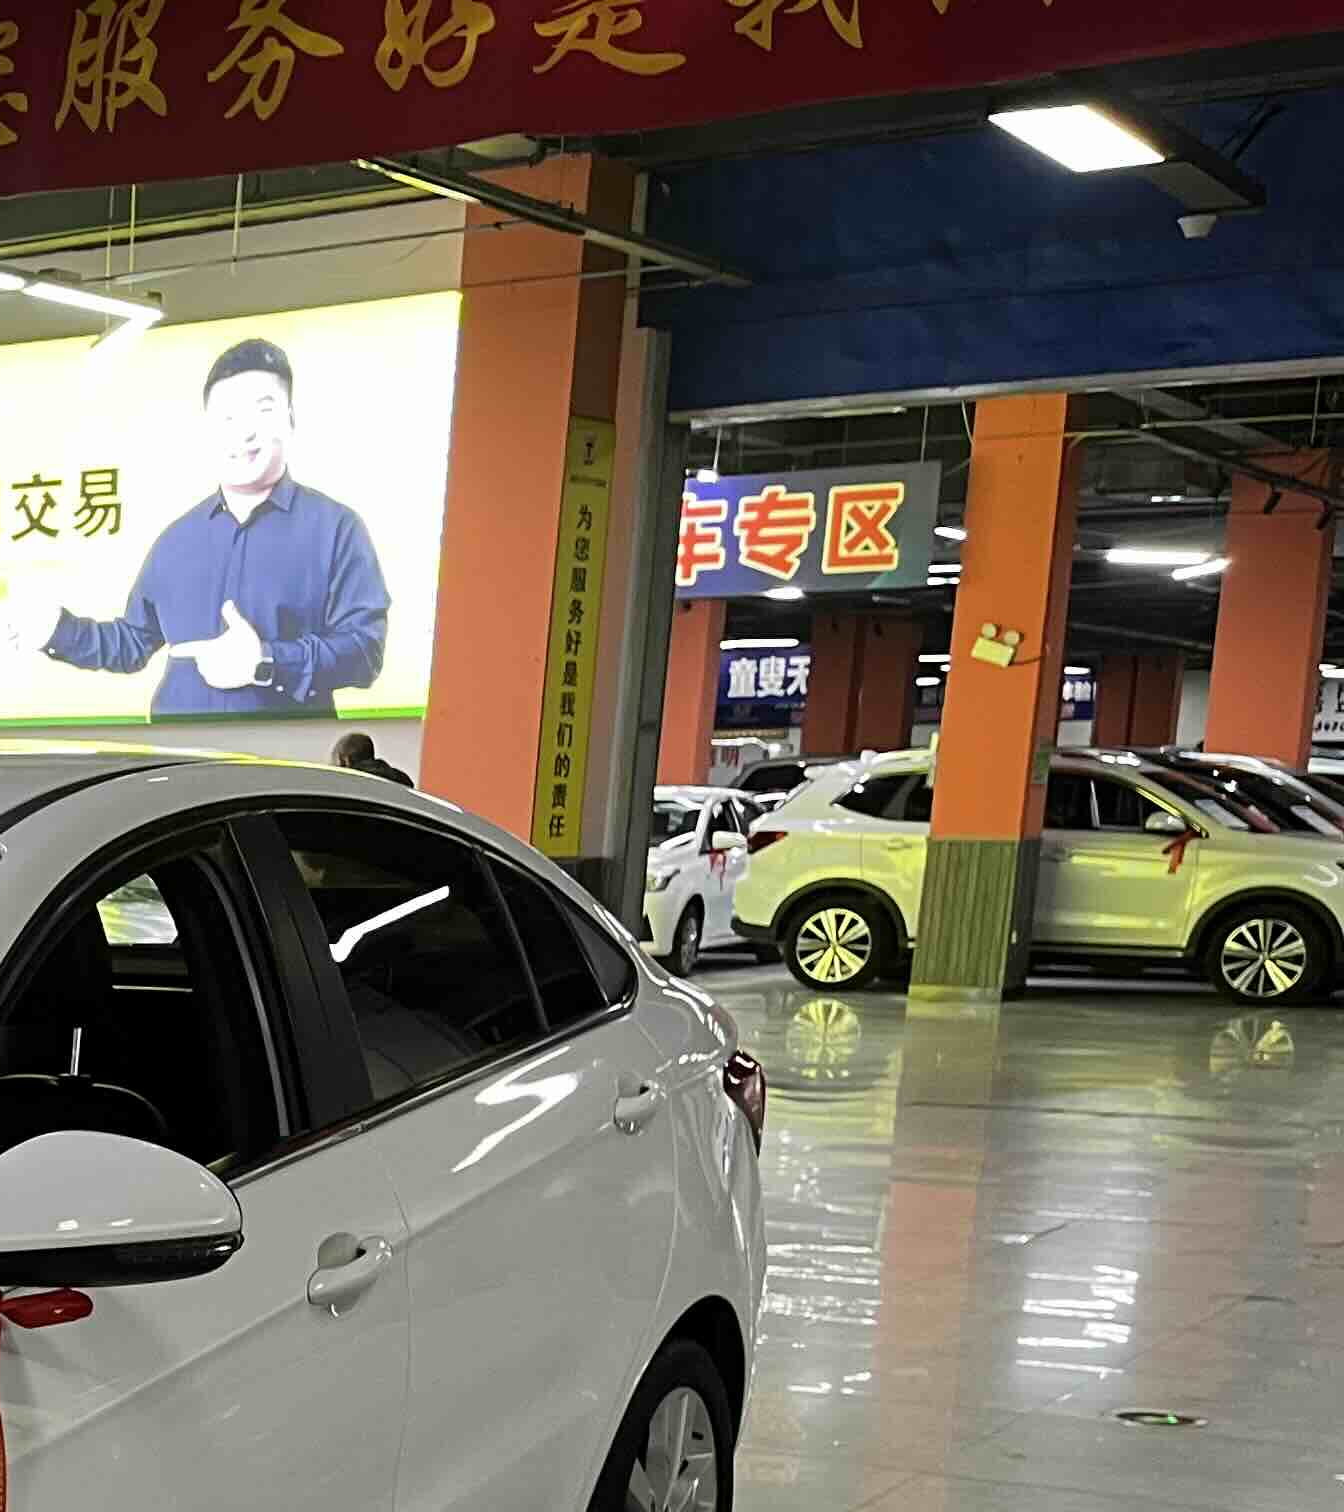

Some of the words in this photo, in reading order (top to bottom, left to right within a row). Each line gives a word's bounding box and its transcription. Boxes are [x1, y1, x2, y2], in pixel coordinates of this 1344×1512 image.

[547, 504, 593, 839] 为您服务好是我们的责任
